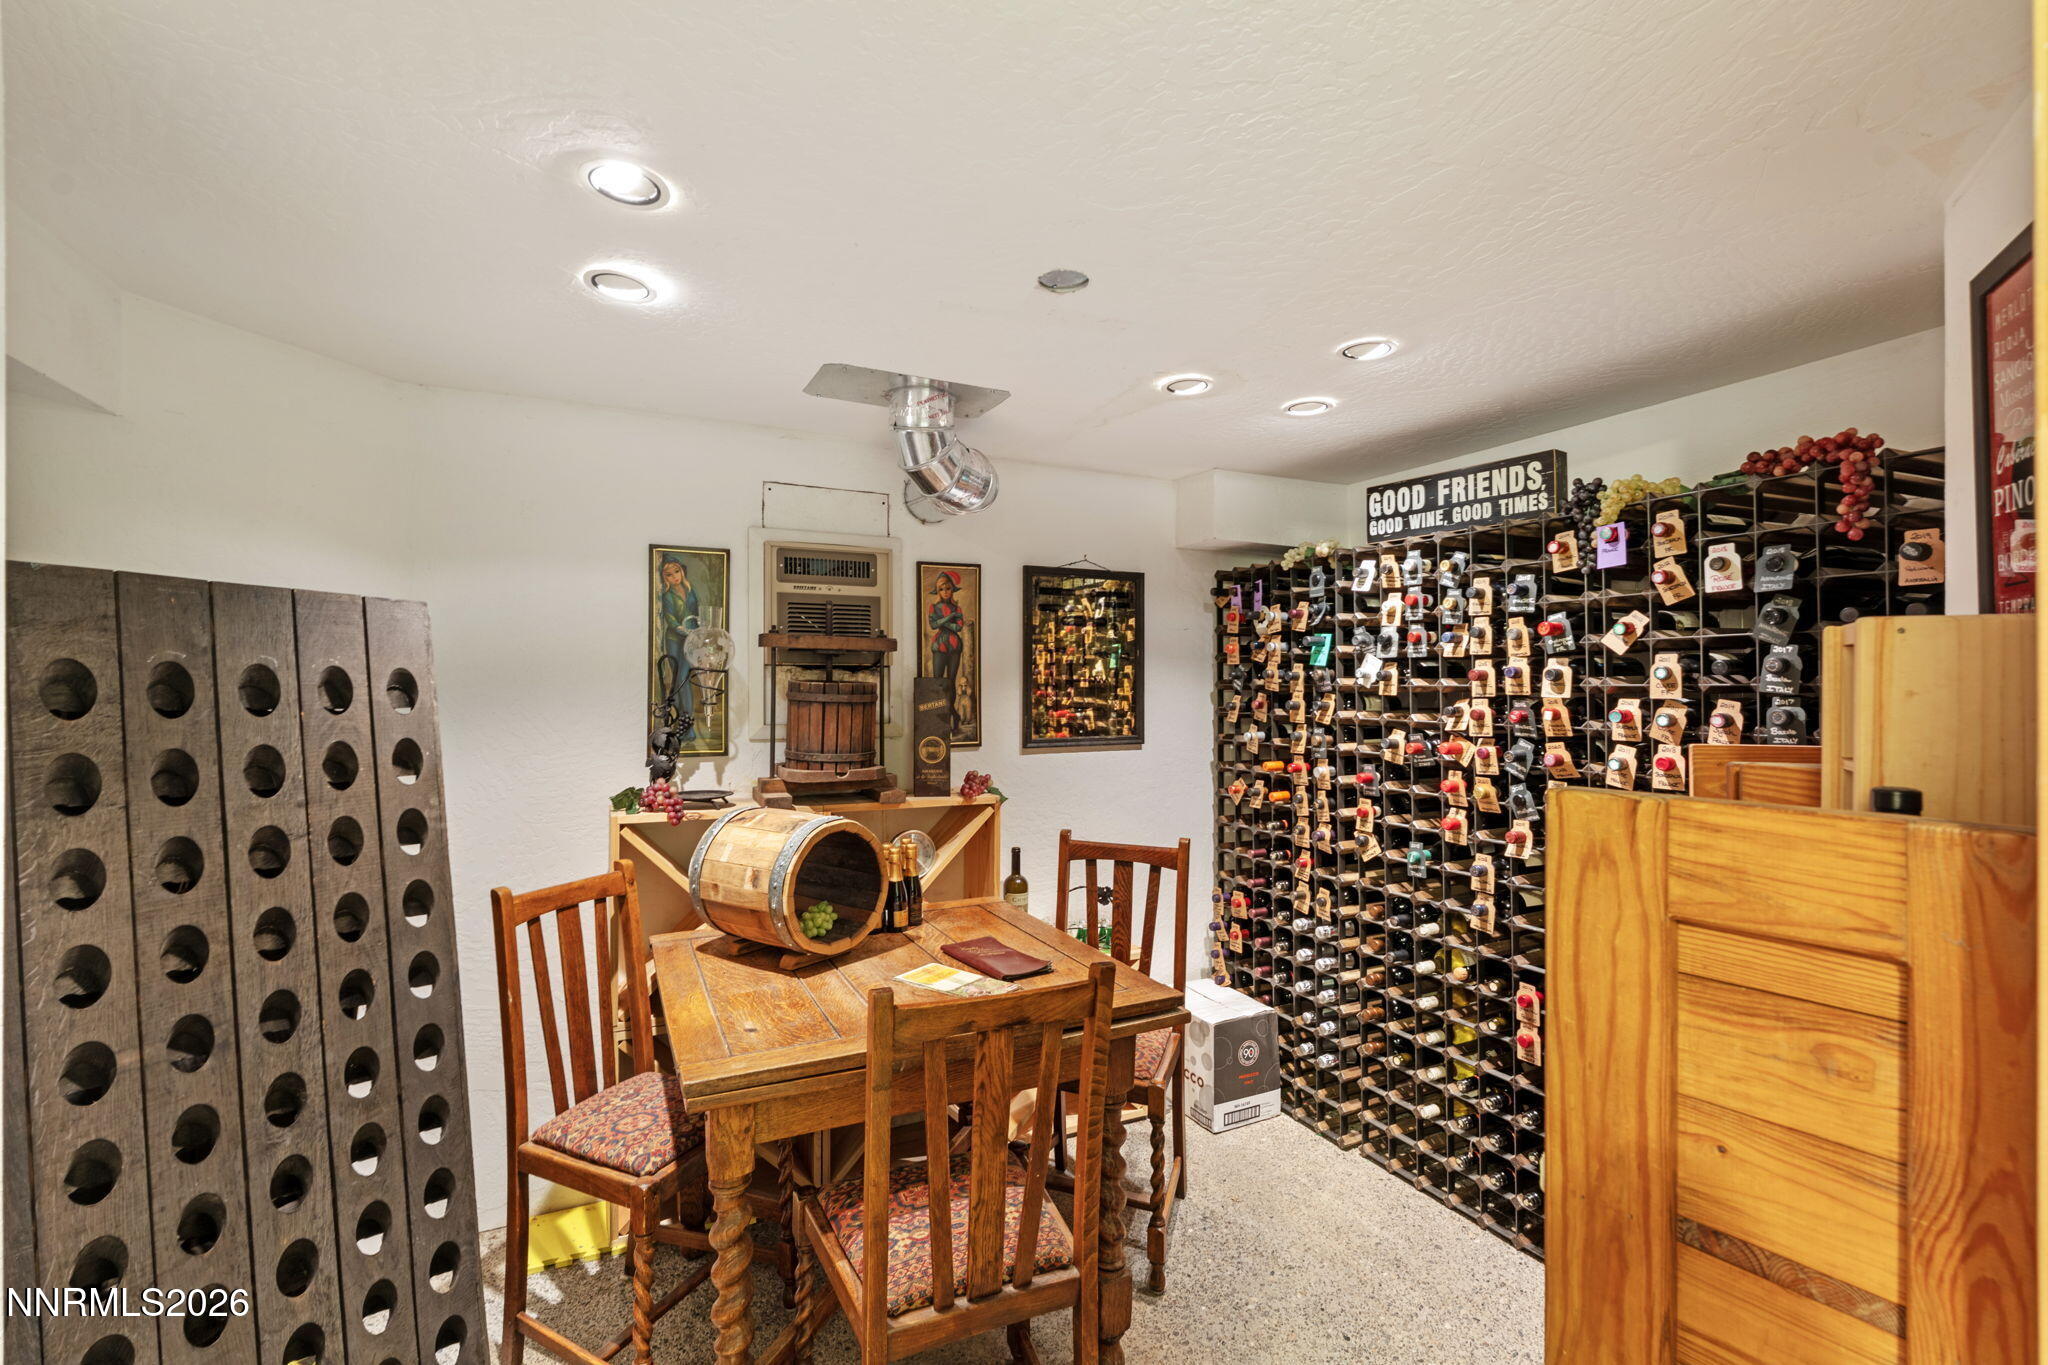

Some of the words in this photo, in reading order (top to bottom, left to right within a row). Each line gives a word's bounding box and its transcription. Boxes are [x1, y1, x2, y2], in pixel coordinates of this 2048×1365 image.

[1369, 484, 1426, 518] GOOD
[1438, 461, 1546, 506] FRIENDS,
[1369, 517, 1403, 536] GOOD
[1409, 509, 1447, 530] WINE,
[1452, 502, 1492, 523] GOOD
[1499, 492, 1548, 516] TIMES
